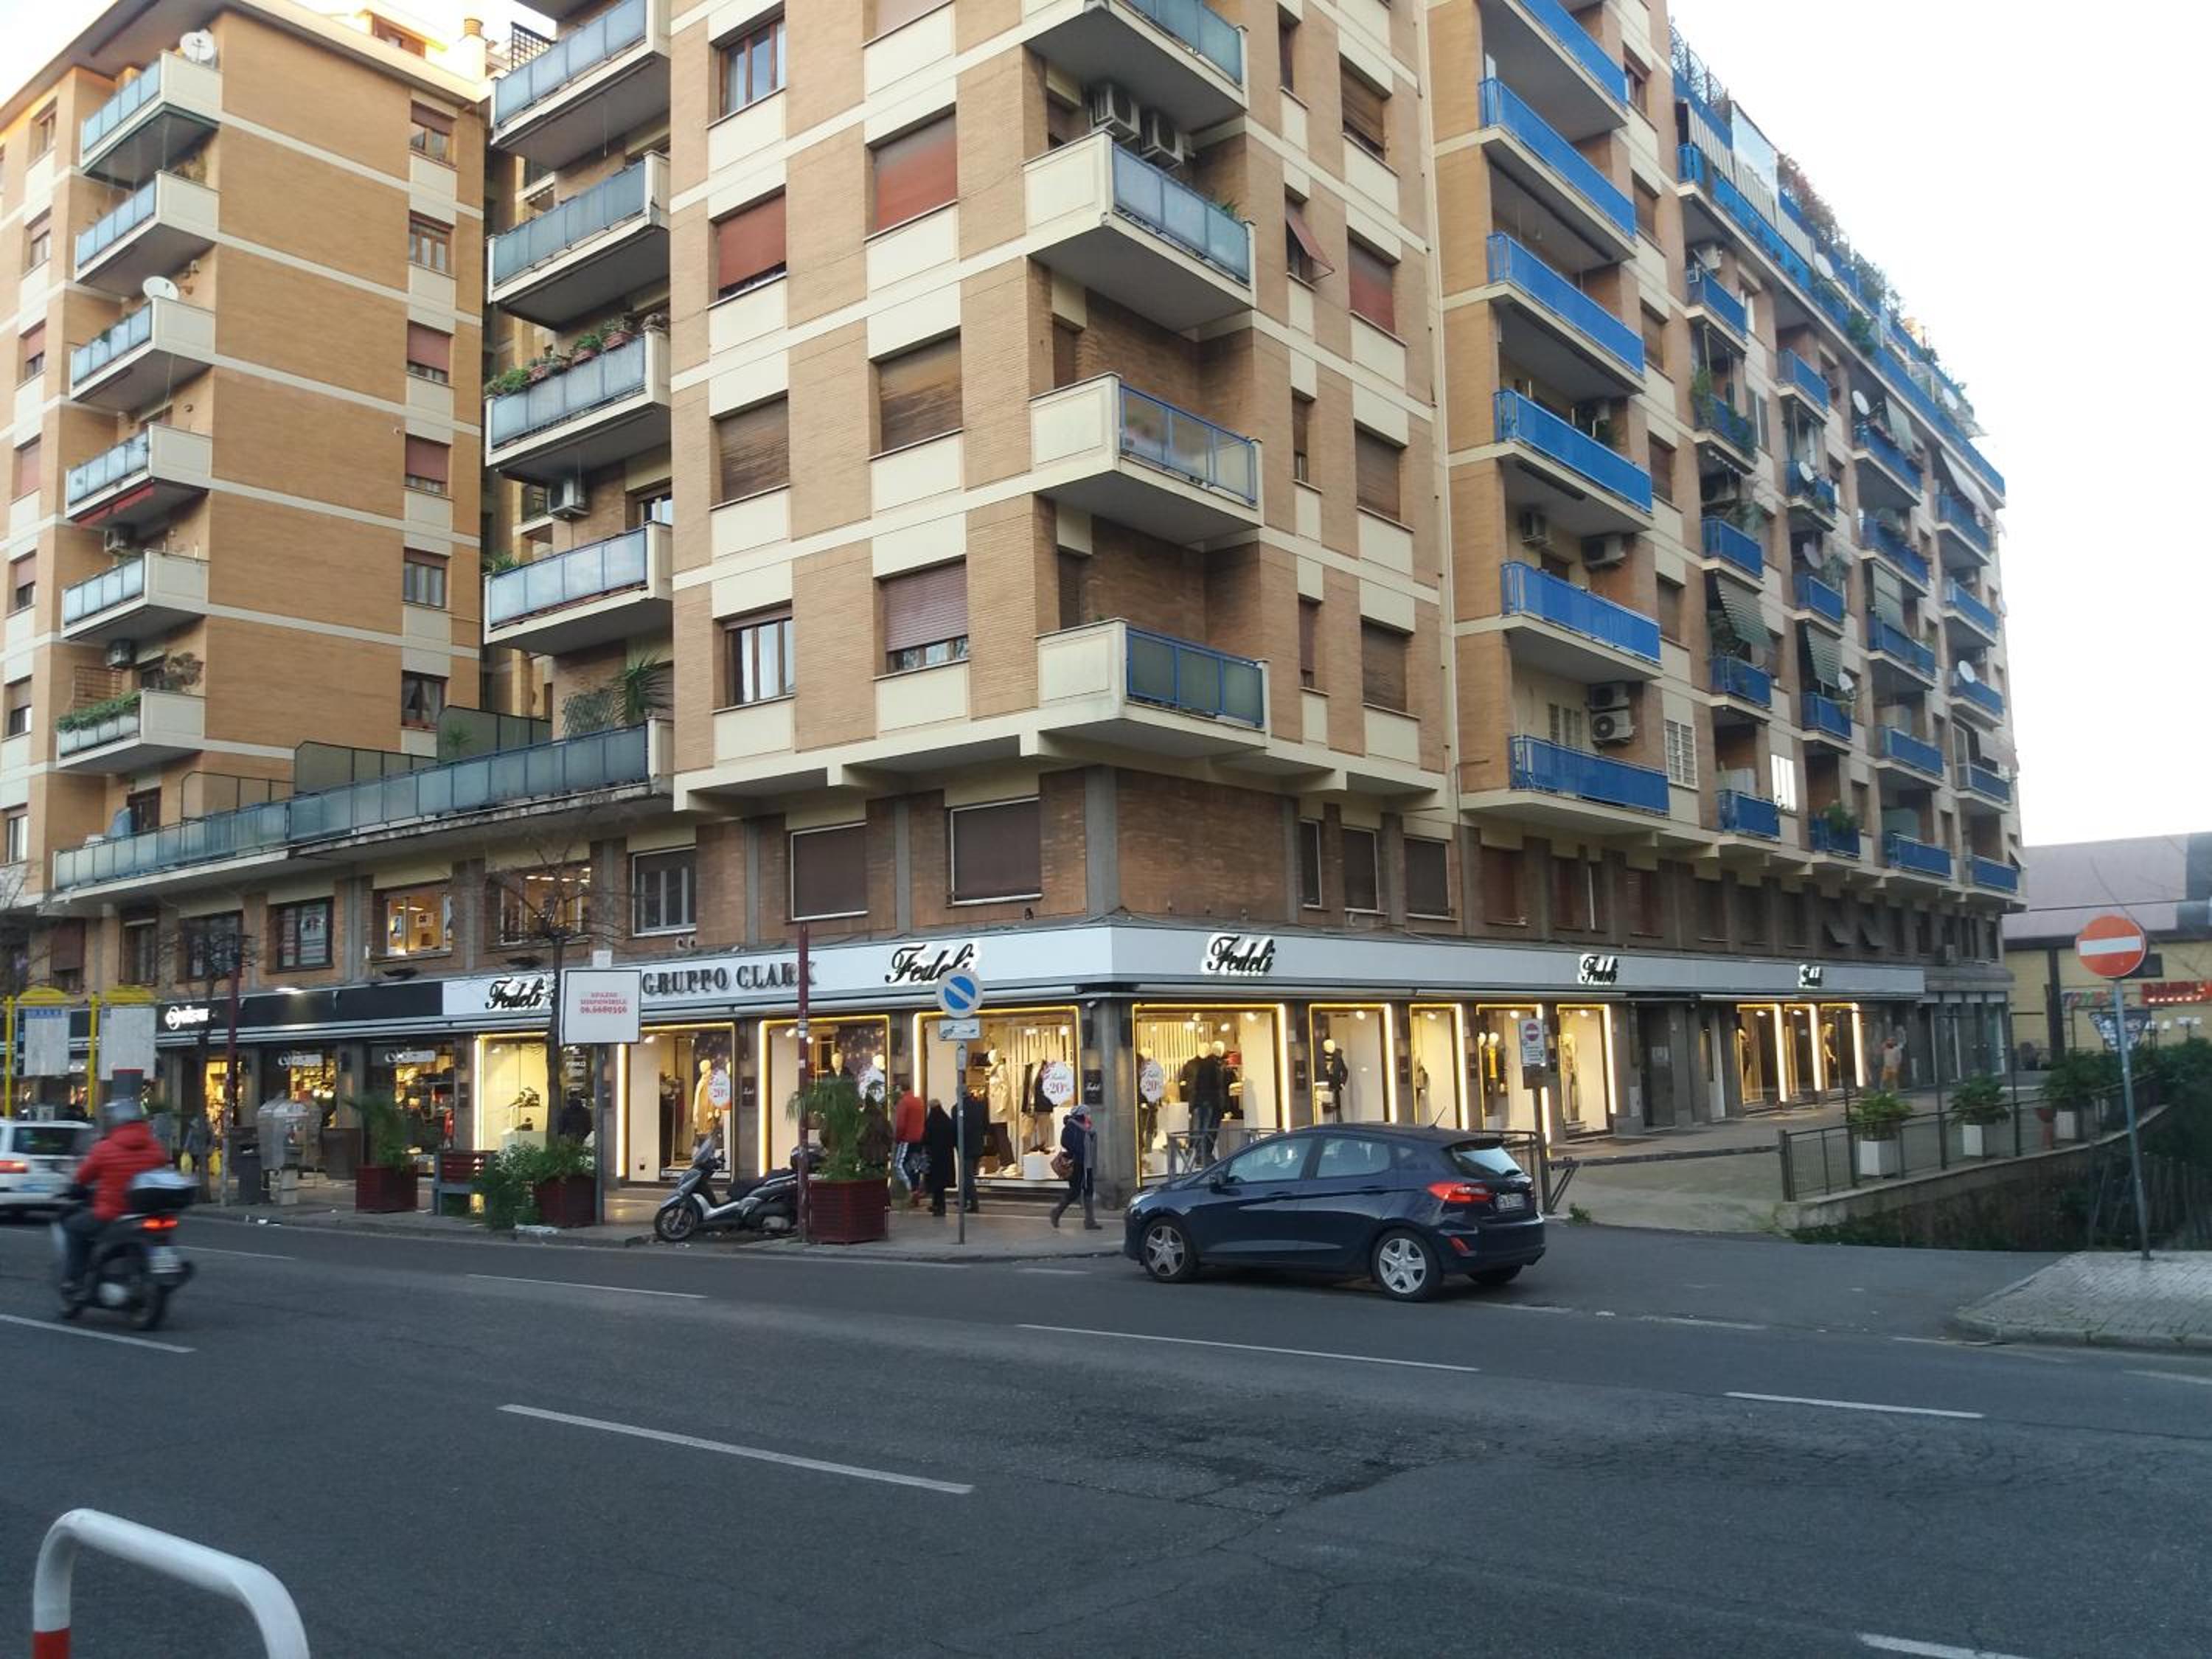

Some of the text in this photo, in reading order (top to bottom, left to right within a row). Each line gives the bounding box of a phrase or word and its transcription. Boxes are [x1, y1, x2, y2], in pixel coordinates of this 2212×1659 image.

[1206, 935, 1276, 973] Fedeli
[642, 967, 729, 995] GRUPPO
[1582, 955, 1618, 983] Fedeli
[484, 978, 545, 1009] Fedeli
